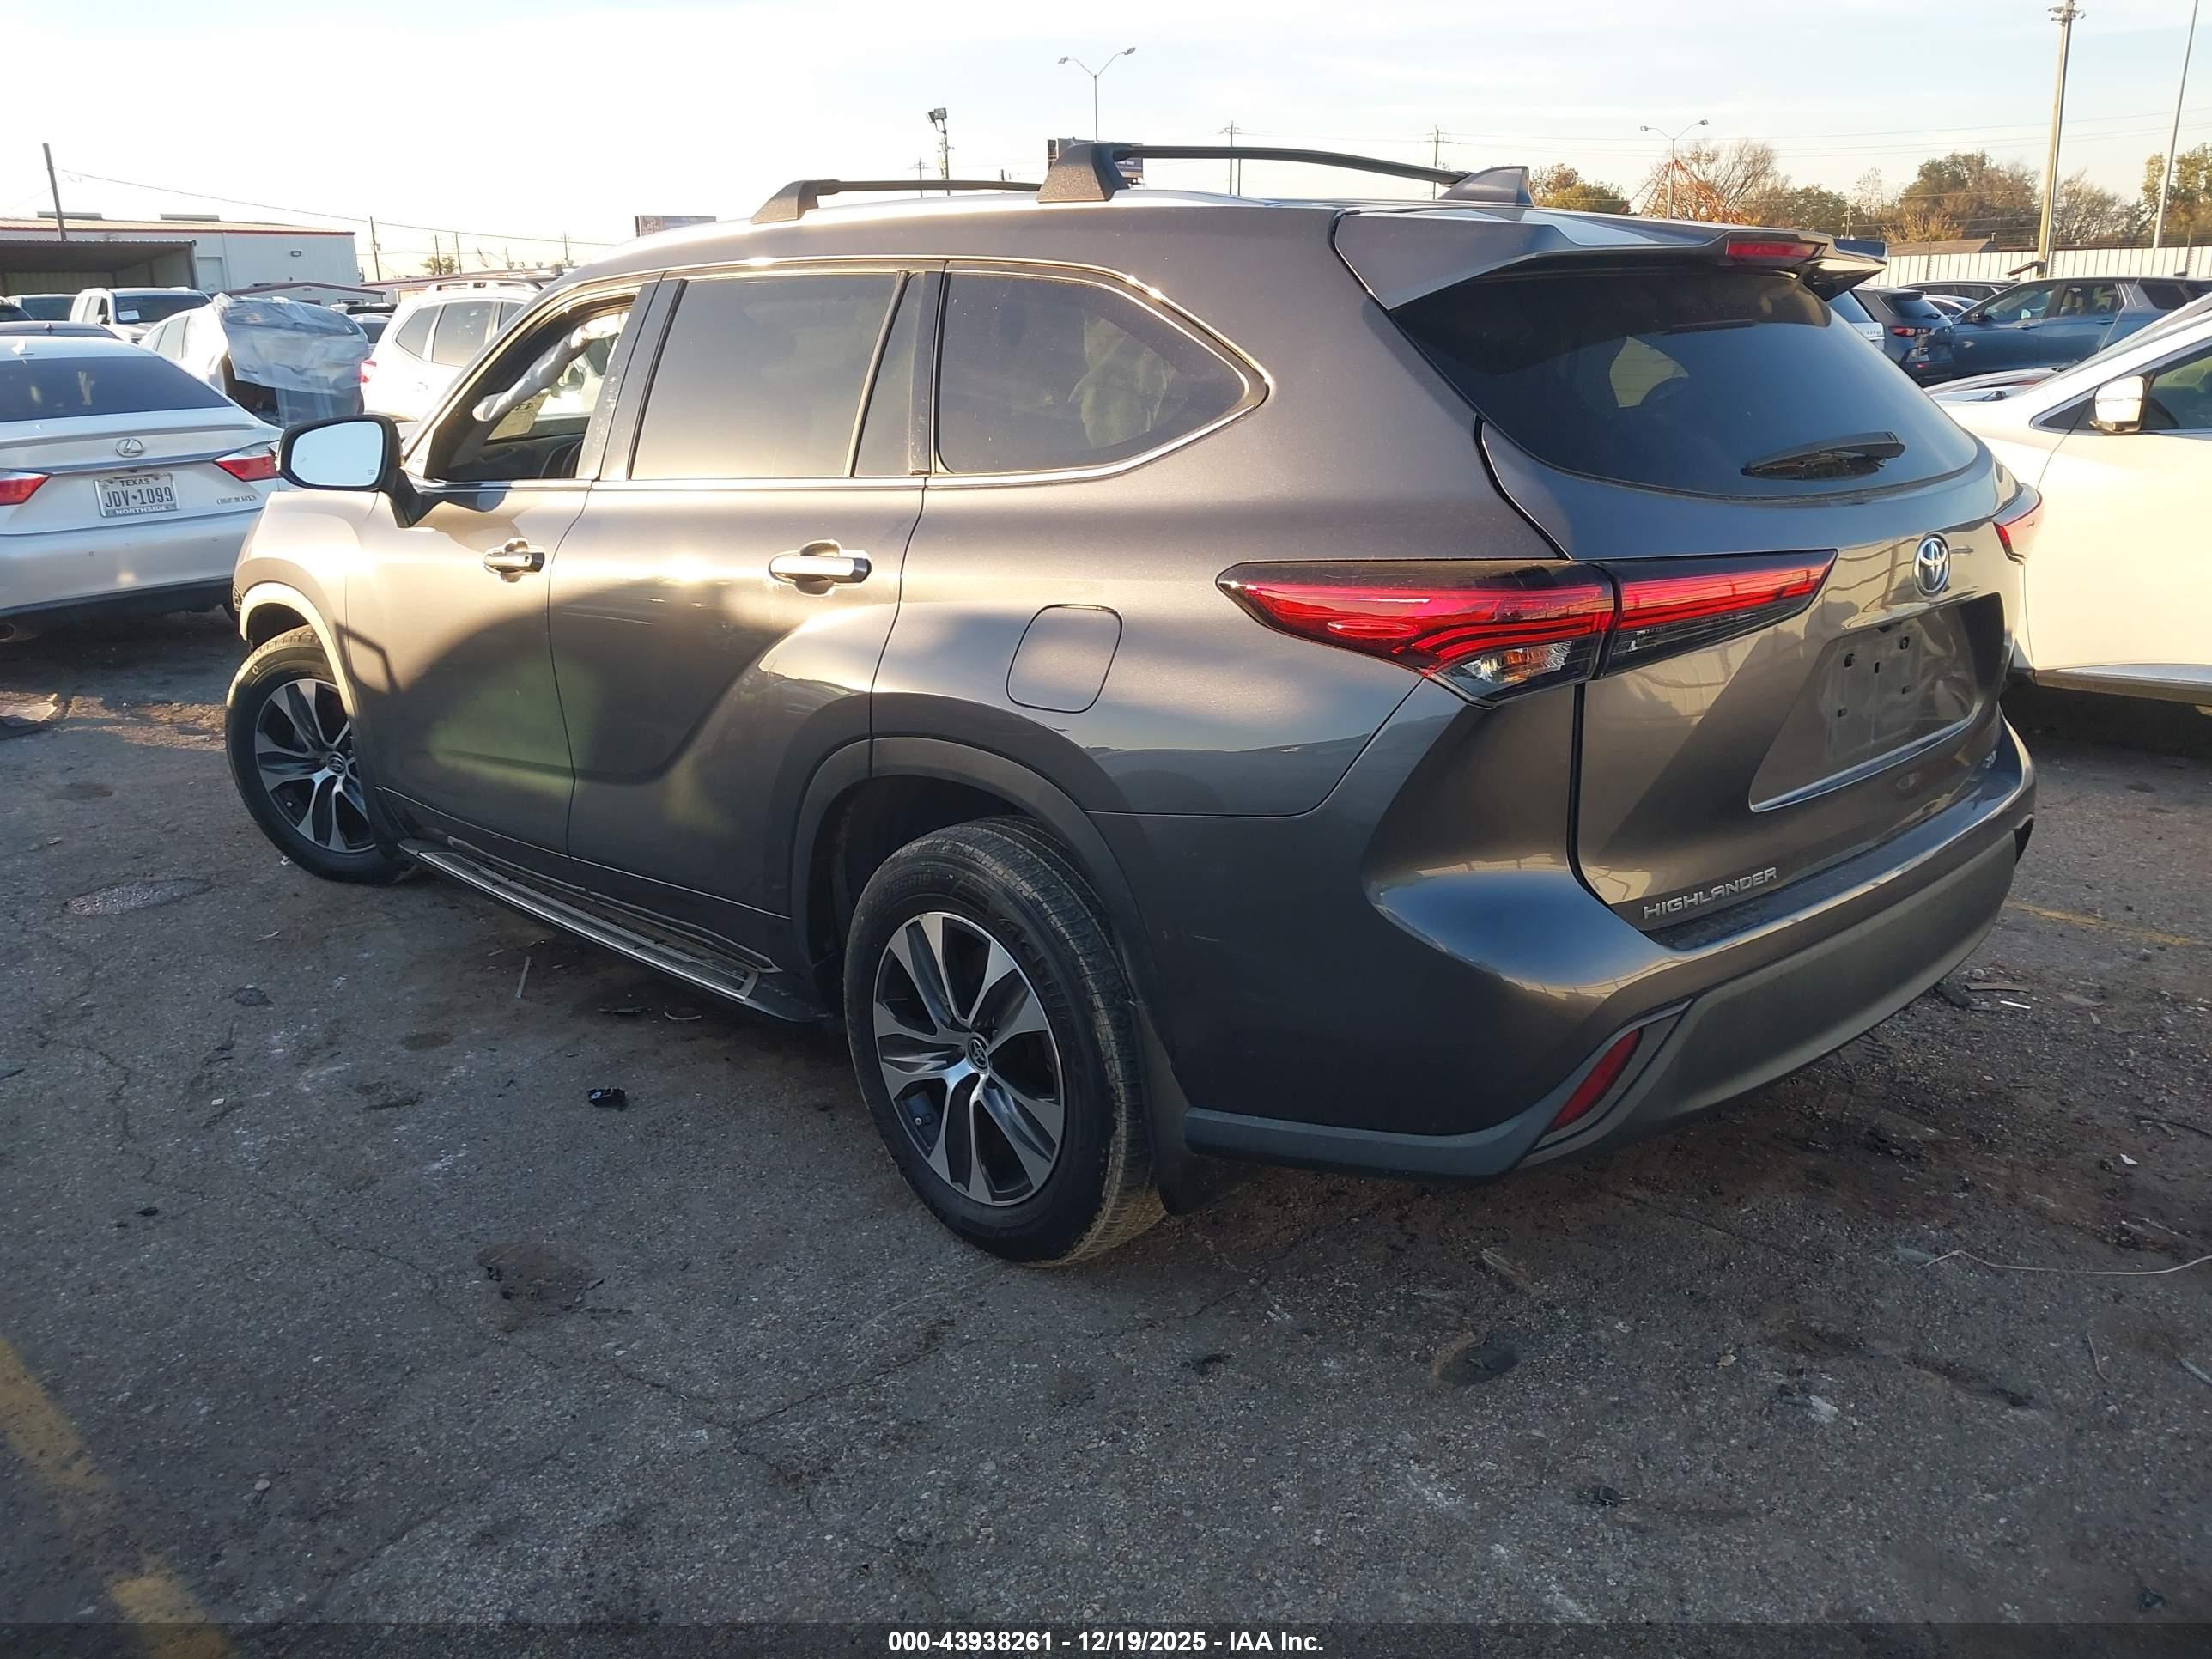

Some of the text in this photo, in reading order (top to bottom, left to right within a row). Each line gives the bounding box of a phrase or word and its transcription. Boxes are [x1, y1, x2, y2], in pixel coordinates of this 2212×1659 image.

[119, 477, 150, 487] TEXAS
[115, 505, 167, 515] NORTHSIDE
[1643, 866, 1778, 920] HIGHLANDER
